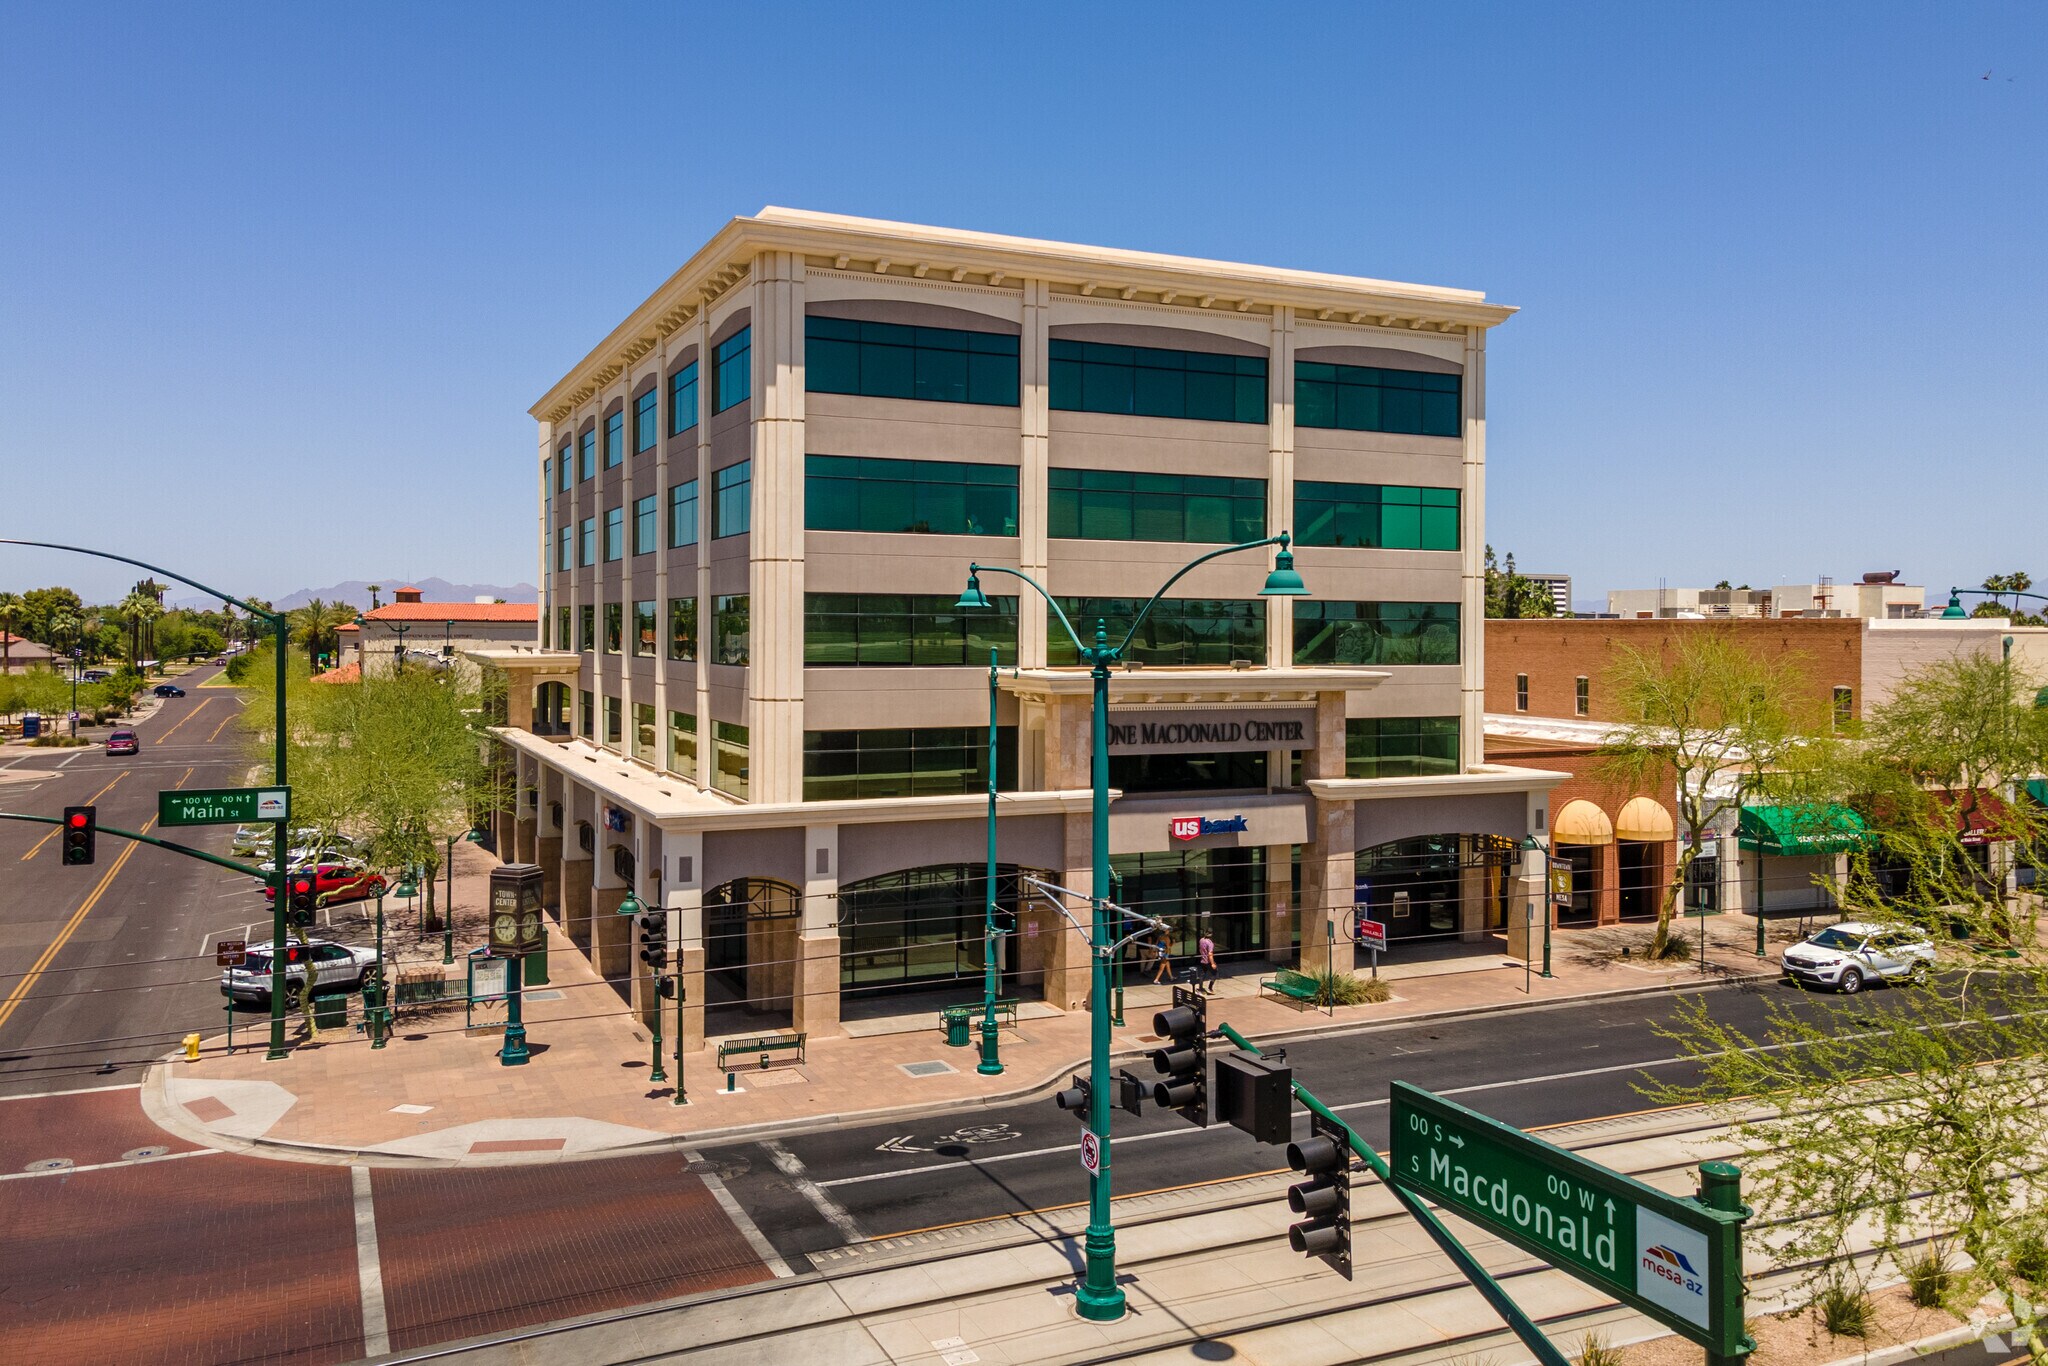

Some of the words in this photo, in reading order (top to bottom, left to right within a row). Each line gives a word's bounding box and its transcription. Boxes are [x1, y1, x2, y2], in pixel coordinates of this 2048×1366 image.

[1141, 723, 1242, 744] MACDONALD
[1245, 720, 1304, 742] CENTER
[236, 795, 242, 803] N
[183, 804, 224, 819] Main
[230, 809, 239, 817] St
[1175, 821, 1199, 836] us
[1200, 814, 1248, 834] bank
[495, 898, 517, 907] CENTER
[499, 890, 515, 898] TOWN
[1410, 1113, 1428, 1136] 00
[1434, 1125, 1442, 1142] S
[1547, 1175, 1570, 1200] 00
[1579, 1187, 1595, 1212] W
[1411, 1155, 1419, 1173] S
[1430, 1147, 1615, 1272] Macdonald
